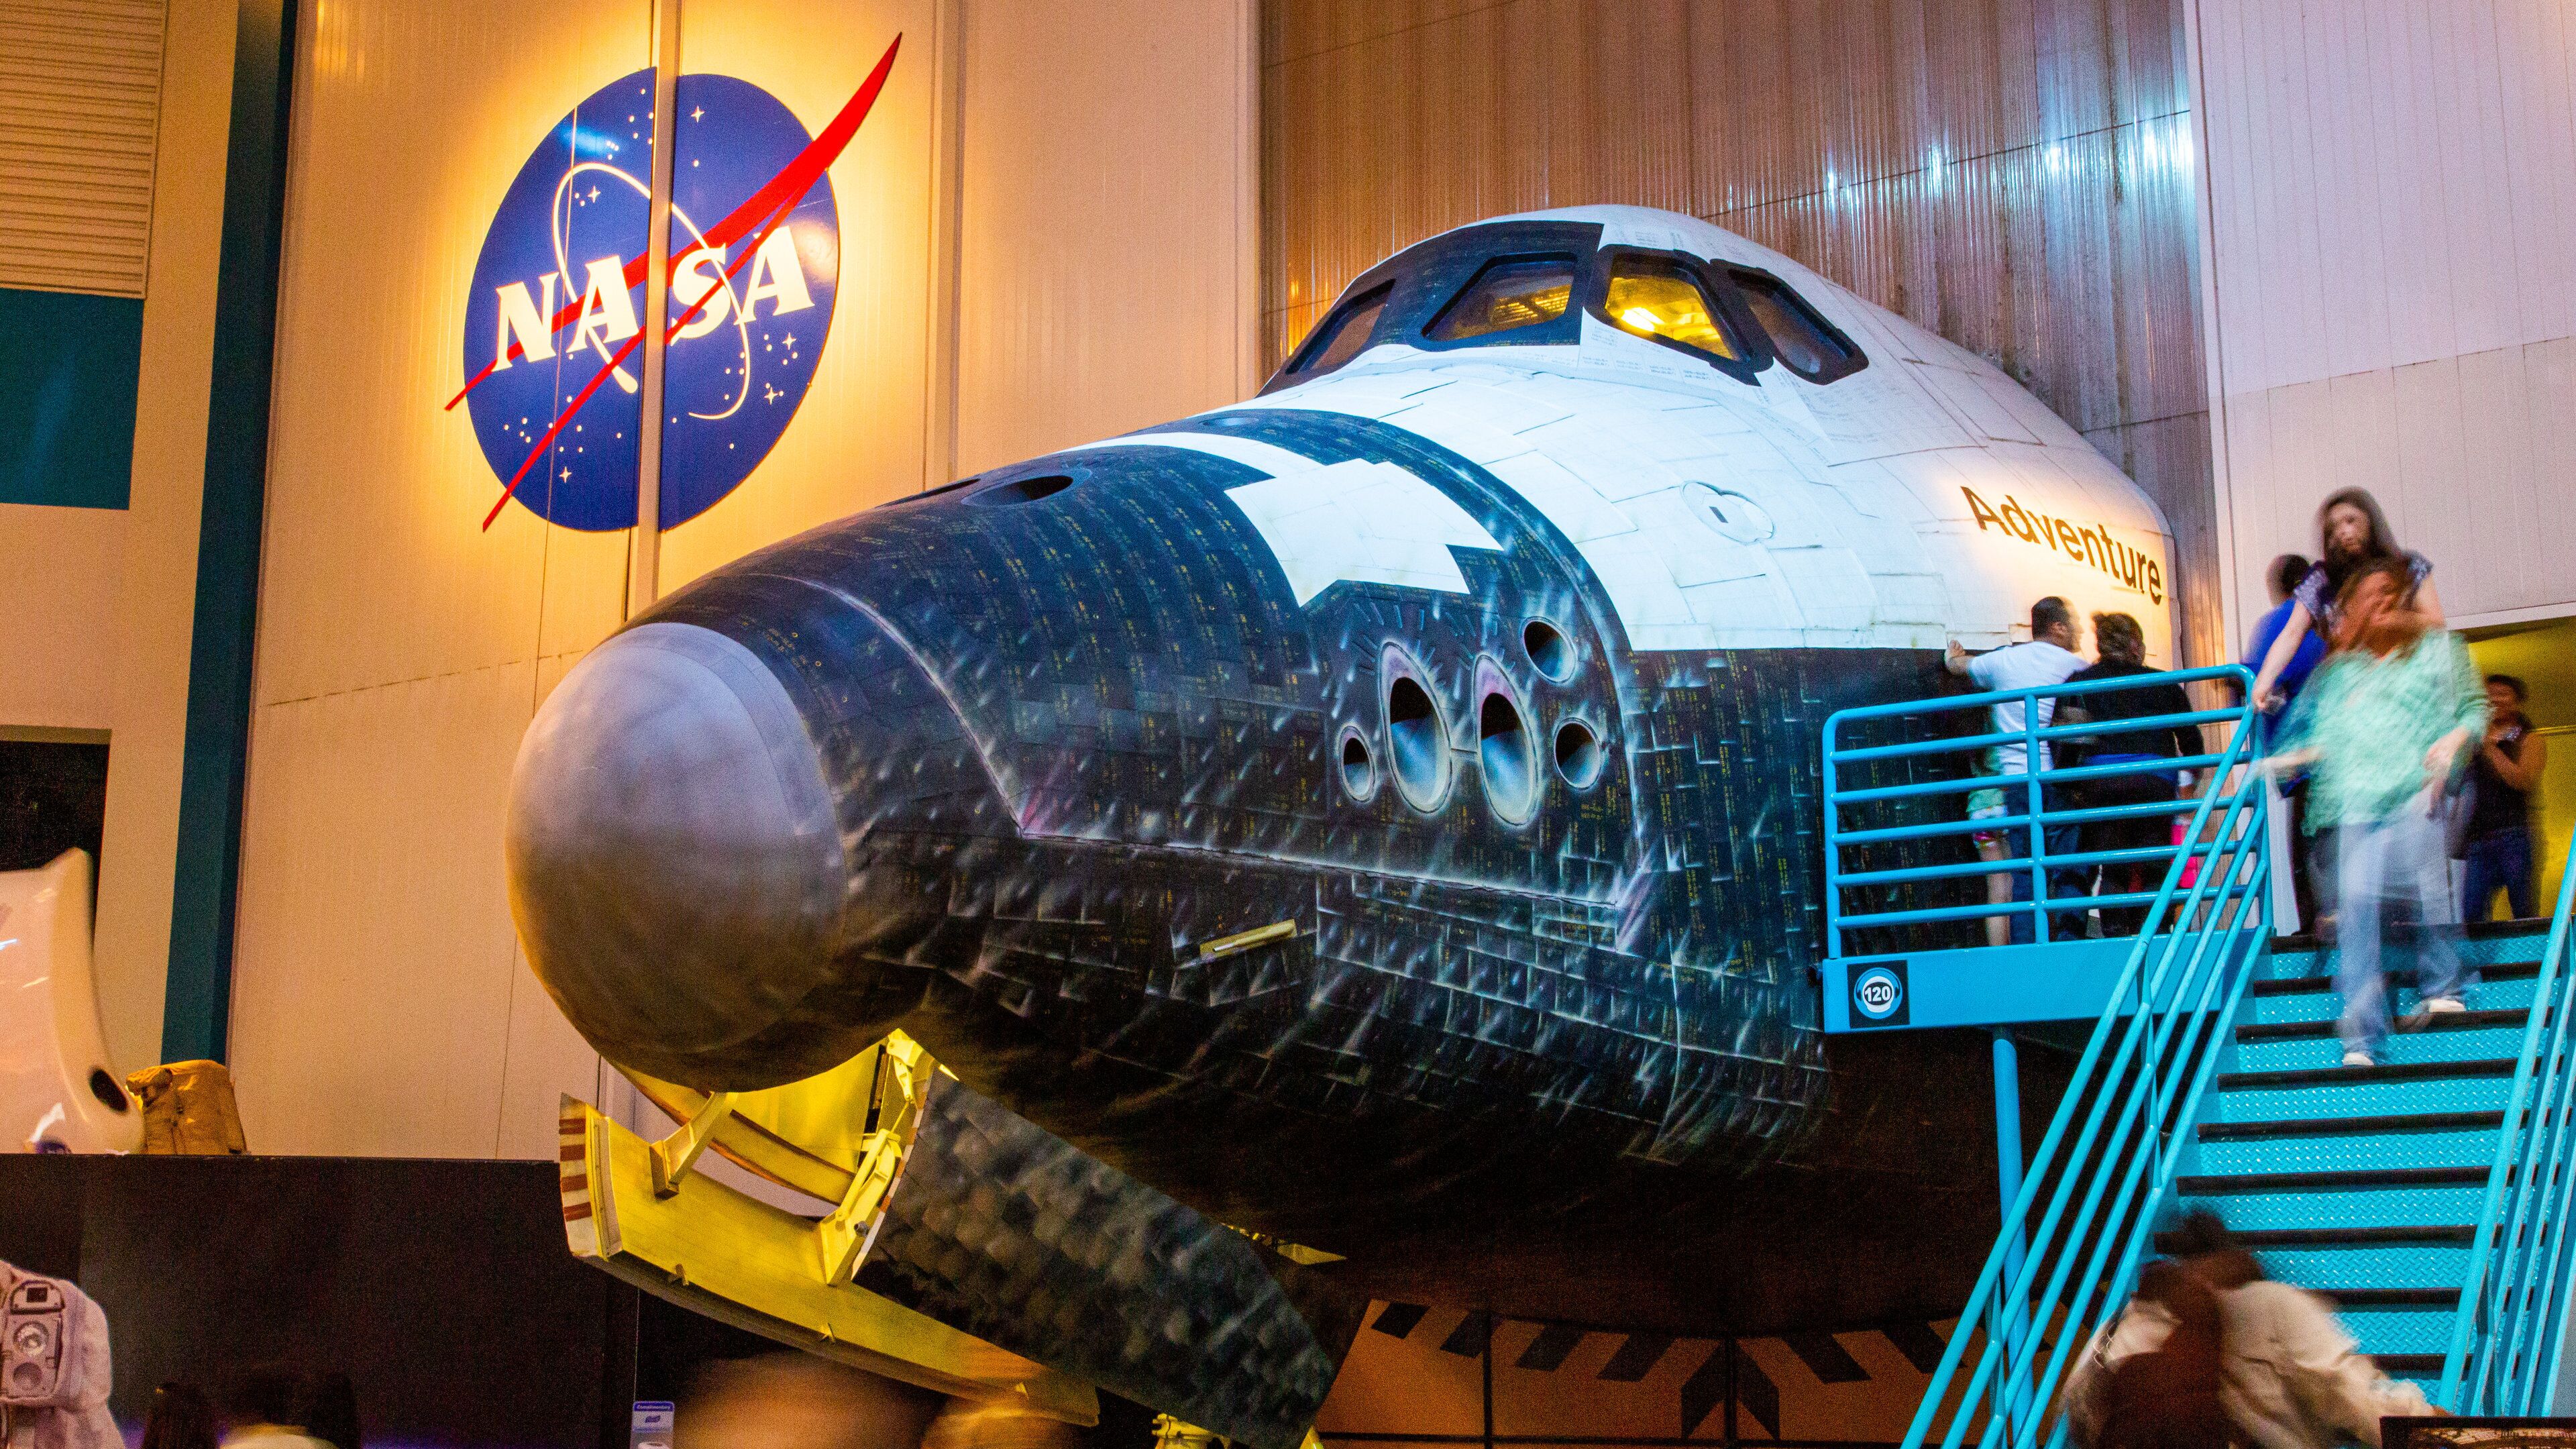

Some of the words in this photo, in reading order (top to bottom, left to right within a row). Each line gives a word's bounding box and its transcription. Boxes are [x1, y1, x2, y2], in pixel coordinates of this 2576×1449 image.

[491, 225, 815, 372] NASA
[1960, 486, 2162, 606] Adventure
[1864, 985, 1891, 1002] 120
